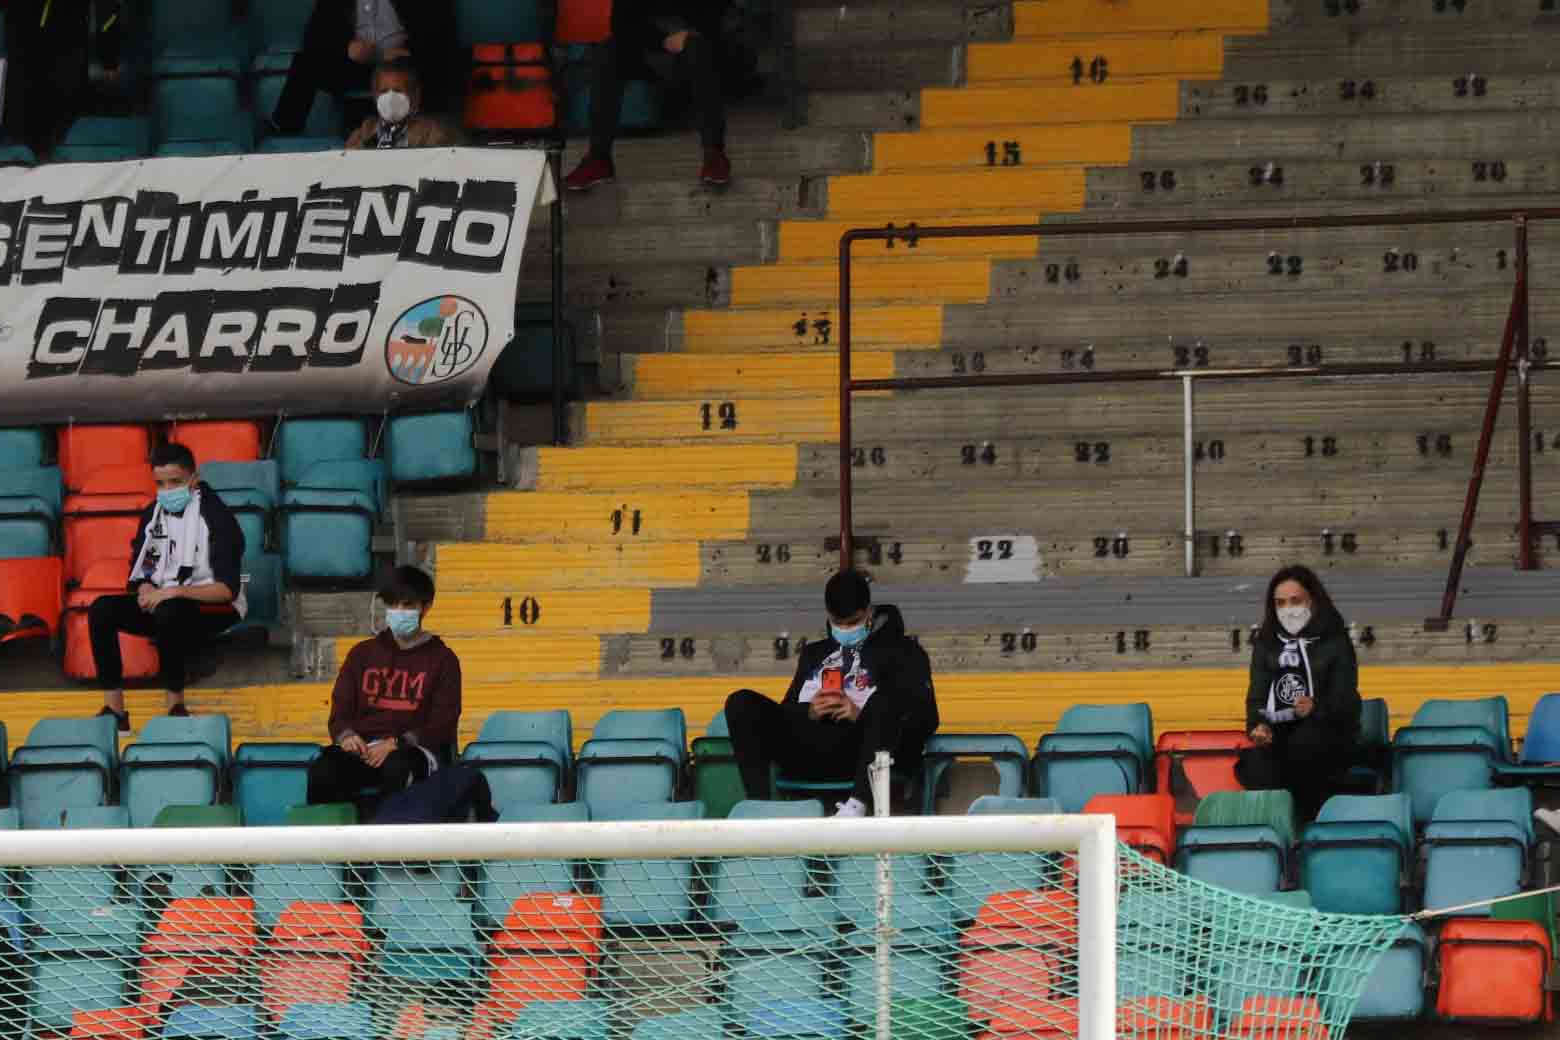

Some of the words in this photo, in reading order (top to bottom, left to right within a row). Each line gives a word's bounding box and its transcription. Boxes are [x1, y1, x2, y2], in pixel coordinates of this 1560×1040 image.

[1069, 56, 1109, 85] 16
[983, 140, 1022, 167] 15
[32, 304, 365, 366] CHARRO
[700, 401, 737, 430] 12
[755, 542, 791, 565] 26
[977, 539, 1014, 561] 22
[1092, 536, 1130, 559] 20
[500, 596, 540, 626] 10
[660, 637, 697, 660] 26
[999, 631, 1038, 654] 20
[361, 667, 426, 699] GYM
